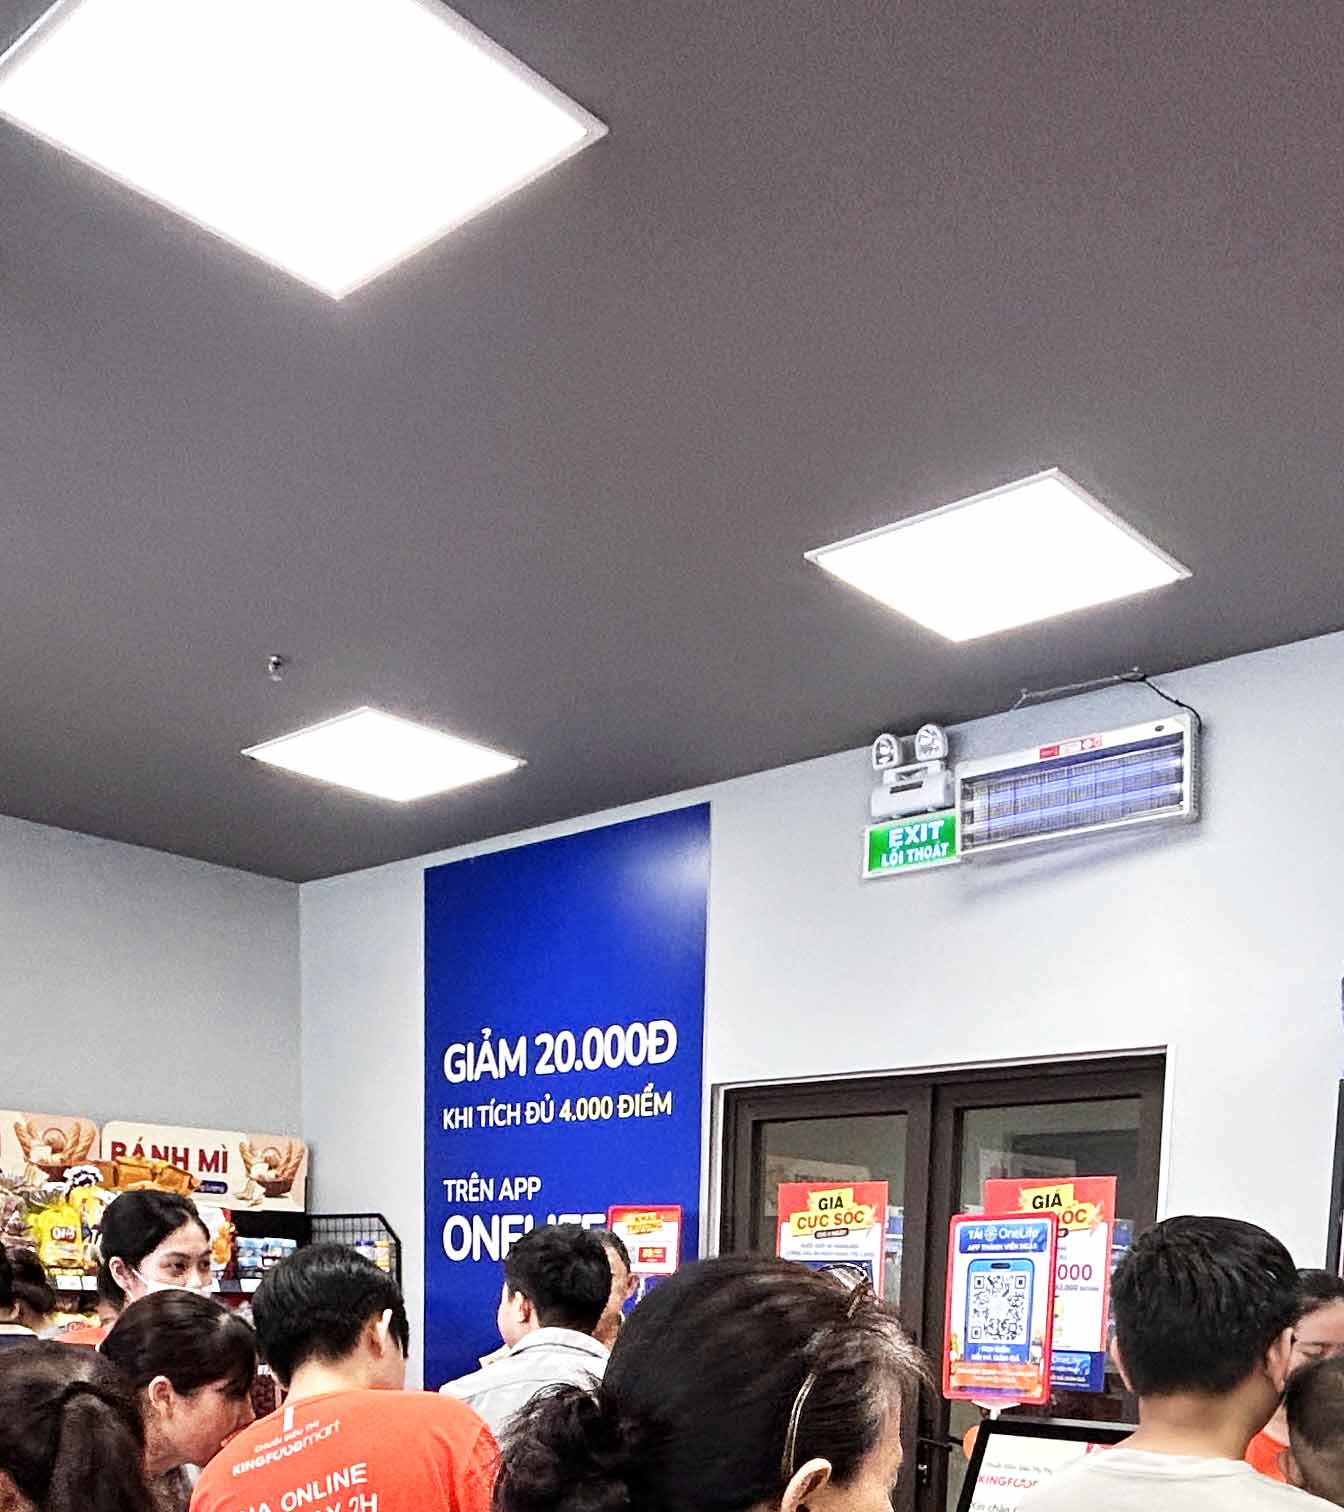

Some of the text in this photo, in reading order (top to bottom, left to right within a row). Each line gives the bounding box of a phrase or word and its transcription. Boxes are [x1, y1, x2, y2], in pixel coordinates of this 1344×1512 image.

[888, 820, 944, 848] EXIT
[443, 1020, 678, 1083] GIẢM 20.000Đ
[443, 1082, 672, 1129] KHI TÍCH ĐỦ 4.000 ĐIỂM
[198, 1144, 228, 1174] MÌ
[443, 1171, 542, 1202] TRÊN APP
[818, 1191, 844, 1210] GIÁ
[1032, 1189, 1063, 1210] GIÁ
[280, 1463, 369, 1512] ONLINE
